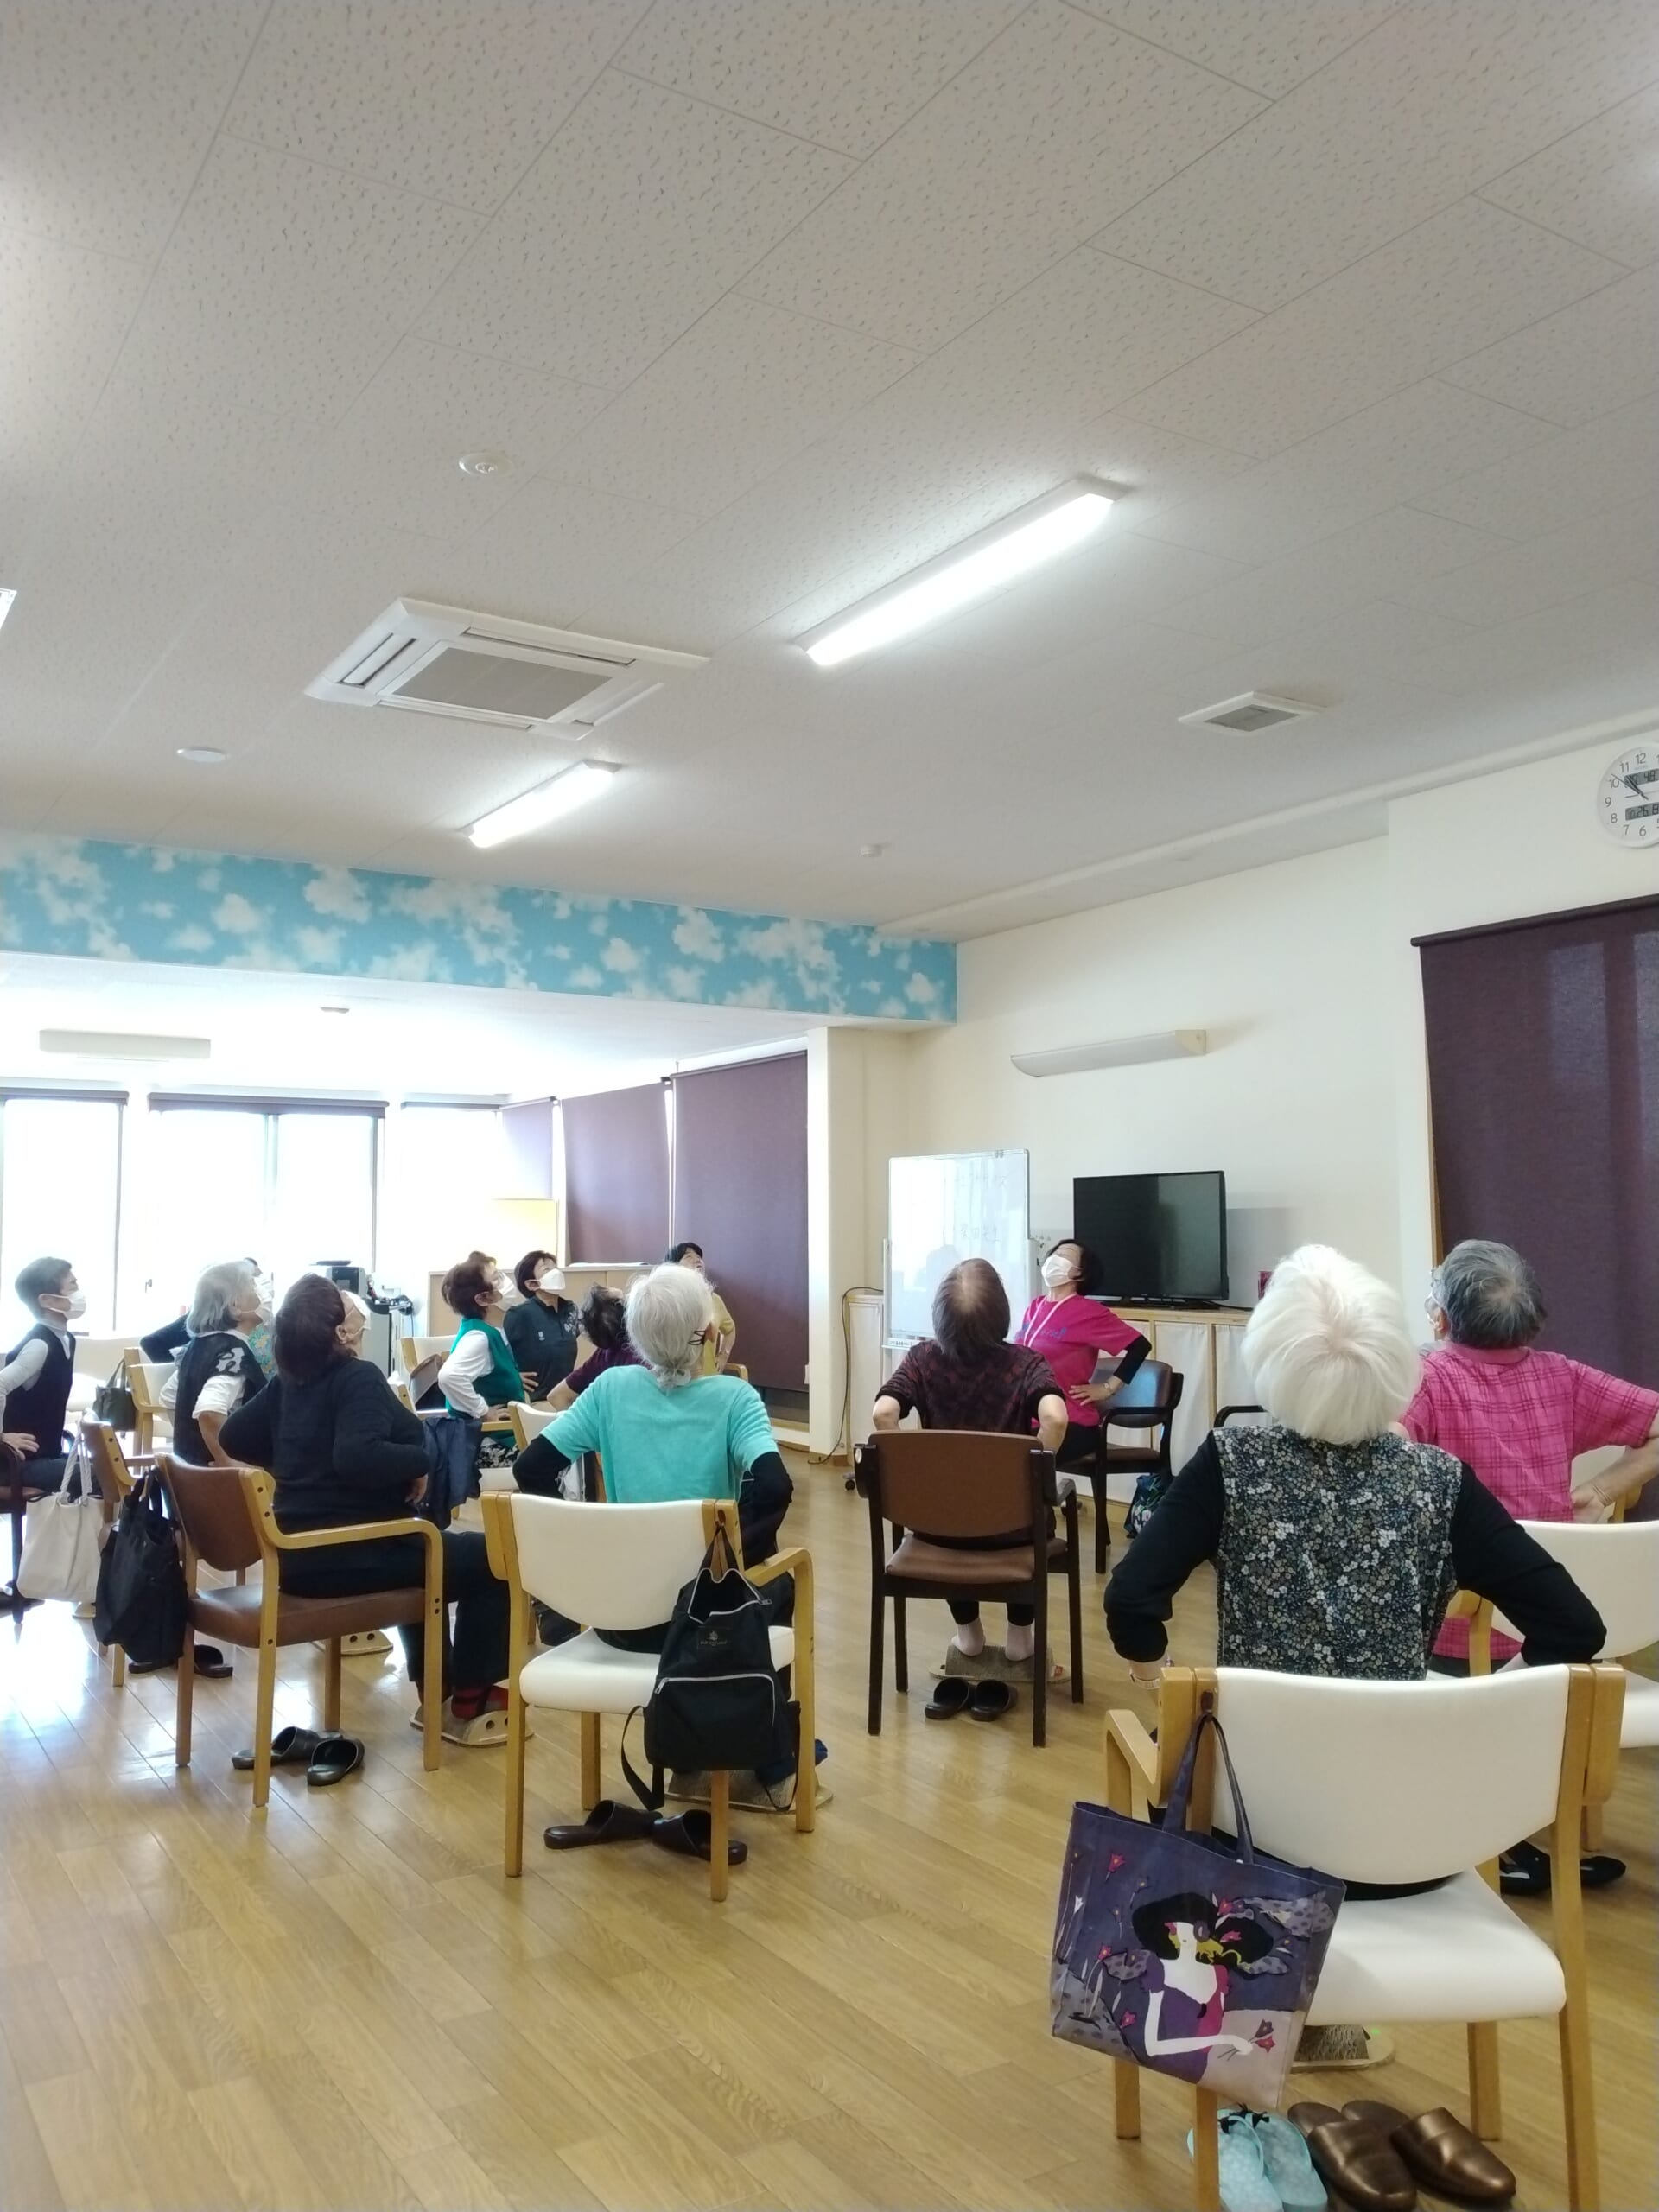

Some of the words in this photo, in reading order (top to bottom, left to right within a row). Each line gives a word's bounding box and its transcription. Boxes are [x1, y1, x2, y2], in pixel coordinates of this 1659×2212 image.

[1635, 753, 1647, 765] 12
[1619, 762, 1630, 772] 11
[1643, 769, 1656, 783] 48
[1609, 779, 1620, 789] 10
[1605, 797, 1612, 808] 9
[1610, 812, 1618, 823] 8
[1623, 824, 1630, 836] 7
[1638, 825, 1647, 837] 6
